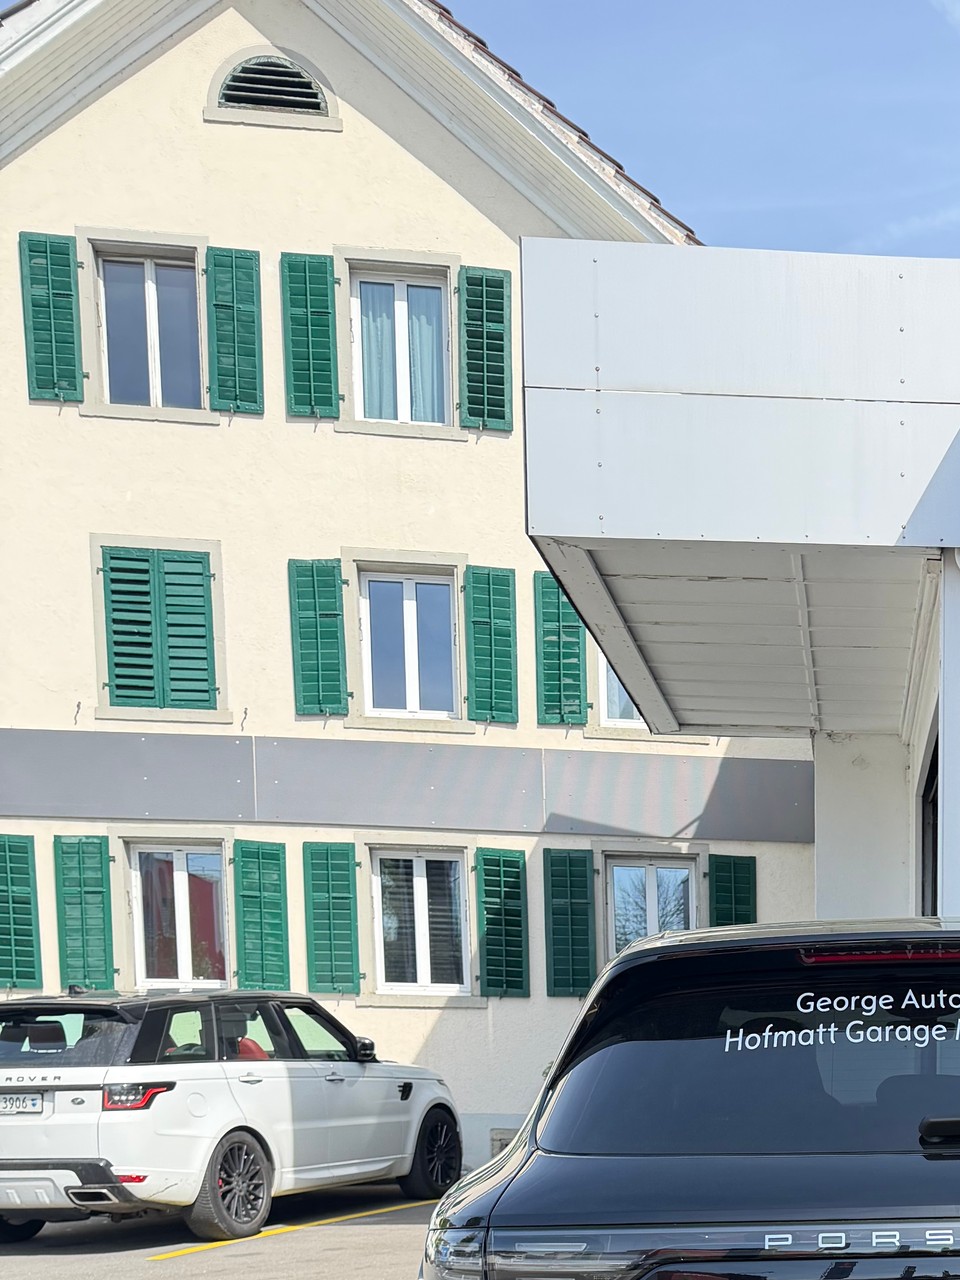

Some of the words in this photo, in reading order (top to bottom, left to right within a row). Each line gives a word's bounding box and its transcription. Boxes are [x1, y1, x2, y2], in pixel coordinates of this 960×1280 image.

[796, 992, 894, 1015] George
[724, 1021, 838, 1052] Hofmatt
[845, 1019, 946, 1048] Garage
[5, 1075, 62, 1083] ROVER
[2, 1096, 28, 1110] 3906
